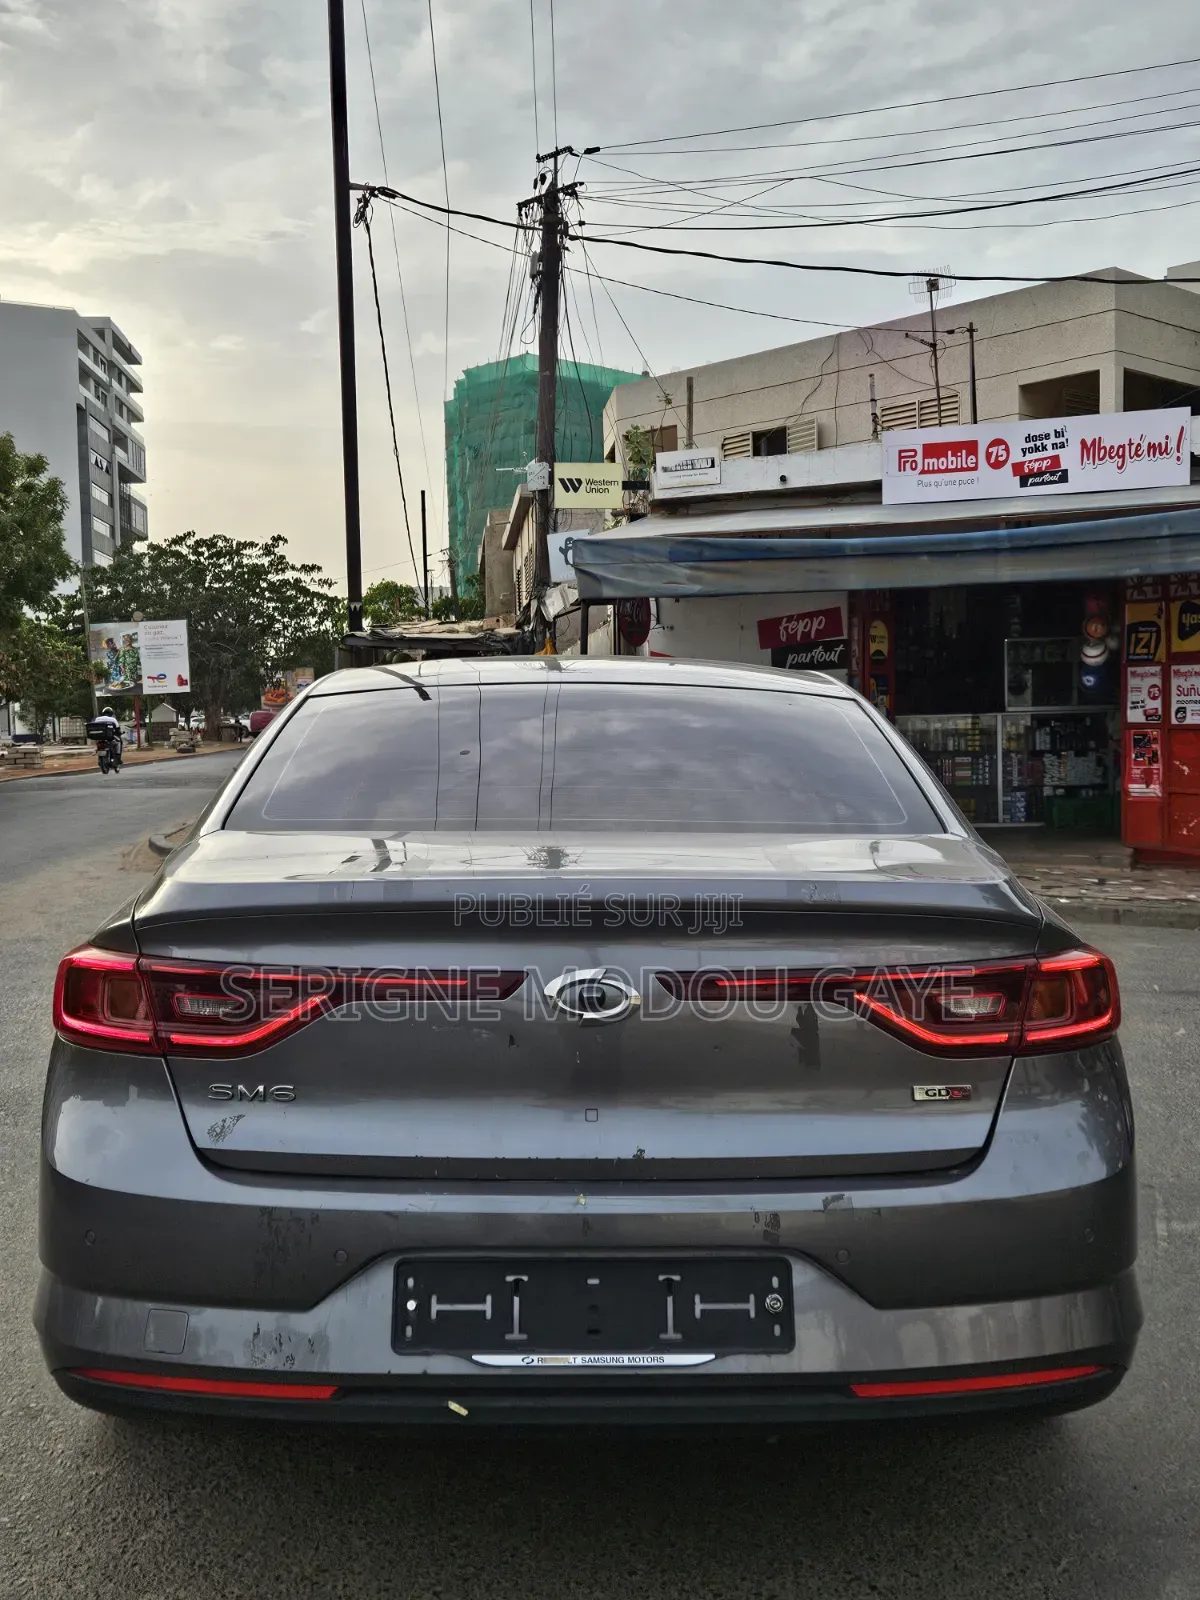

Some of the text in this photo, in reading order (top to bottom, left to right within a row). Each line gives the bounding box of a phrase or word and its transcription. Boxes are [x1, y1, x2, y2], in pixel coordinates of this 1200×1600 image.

[1025, 428, 1065, 444] dose bi
[988, 444, 1007, 464] 75
[1021, 438, 1069, 457] yokk na!
[1080, 434, 1146, 472] Mbegté
[1146, 434, 1174, 460] mi
[897, 448, 977, 472] Pro mobile
[1023, 458, 1052, 473] fépp
[584, 478, 619, 487] Western
[917, 480, 932, 488] Plus
[934, 478, 957, 489] qu'une
[958, 478, 975, 486] puce
[1027, 472, 1062, 487] partout
[584, 486, 610, 494] Union
[779, 615, 826, 642] fépp
[1129, 632, 1157, 654] IZI
[785, 644, 846, 669] partout
[208, 1084, 297, 1102] SM6
[581, 1356, 625, 1364] SAMSUNG
[627, 1355, 665, 1364] MOTORS
